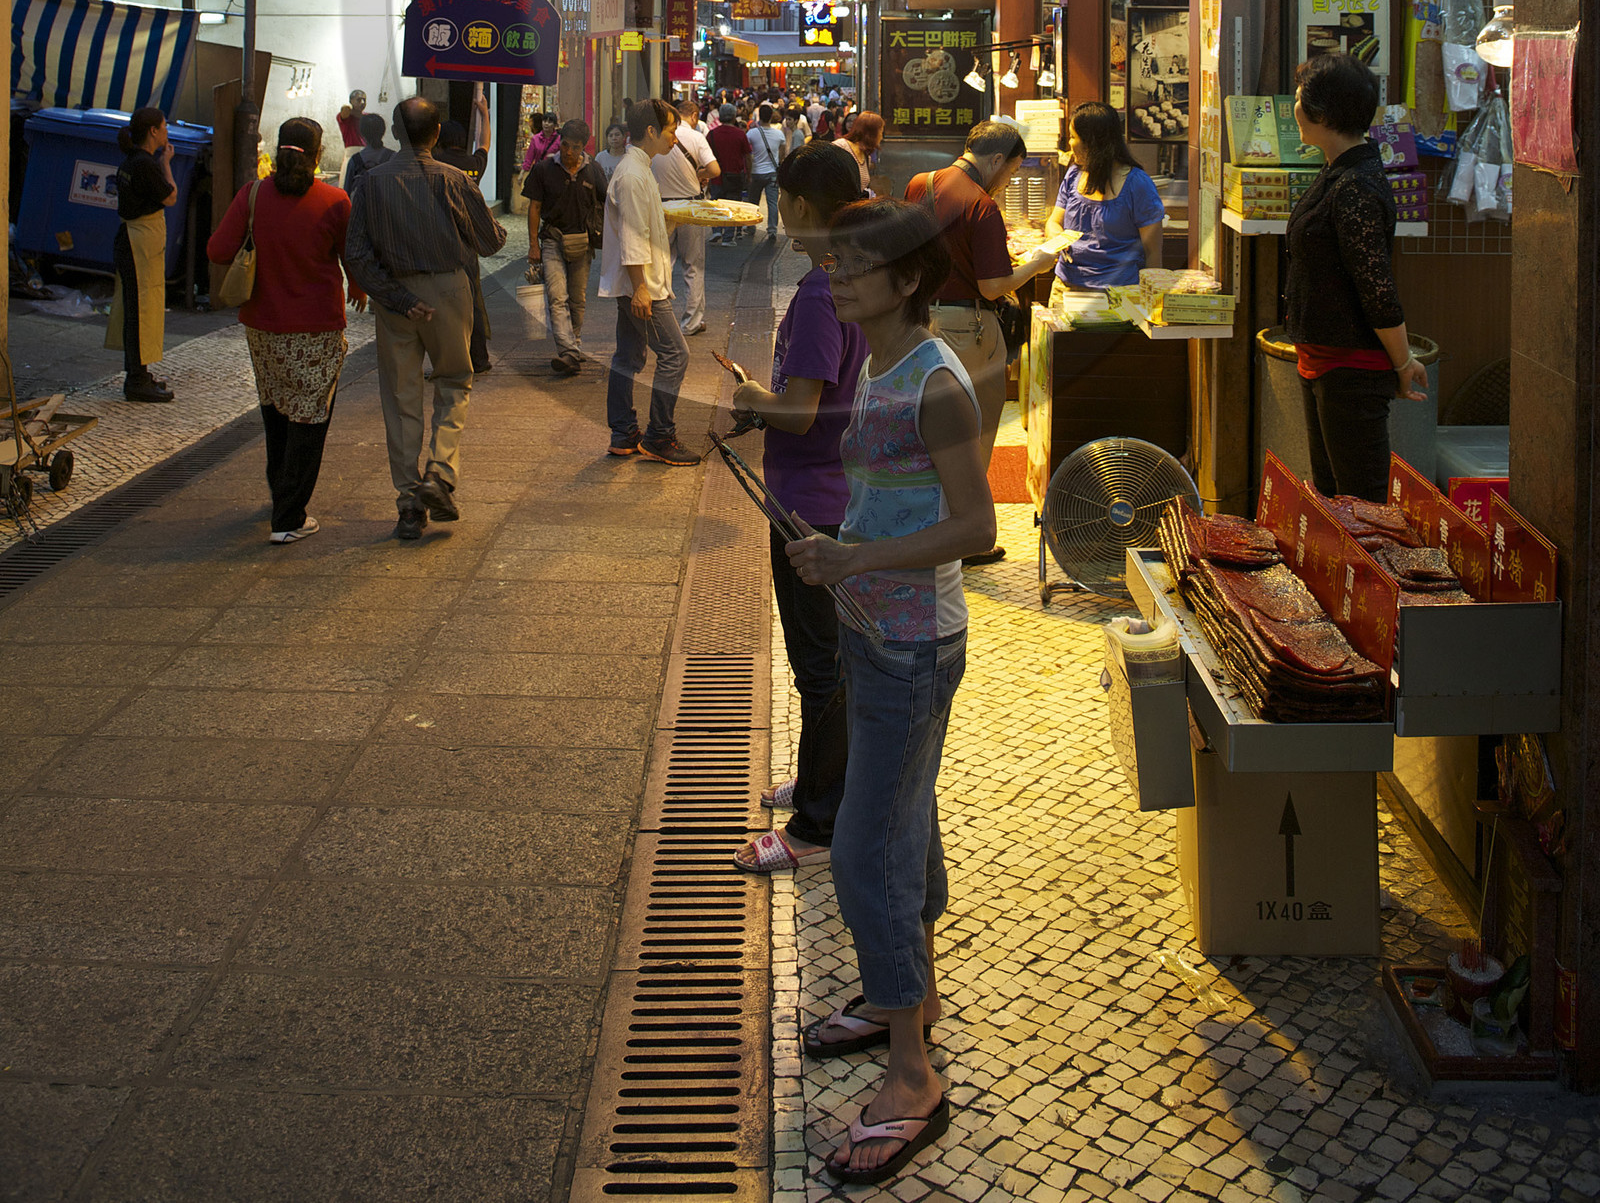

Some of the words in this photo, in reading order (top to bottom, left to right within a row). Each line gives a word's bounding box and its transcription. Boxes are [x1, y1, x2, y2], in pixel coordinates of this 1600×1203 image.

[428, 22, 451, 47] 飯
[505, 30, 536, 50] 飲品
[889, 30, 977, 48] 大三巴餅家
[893, 108, 973, 125] 澳門名牌
[1493, 522, 1506, 581] 果汁
